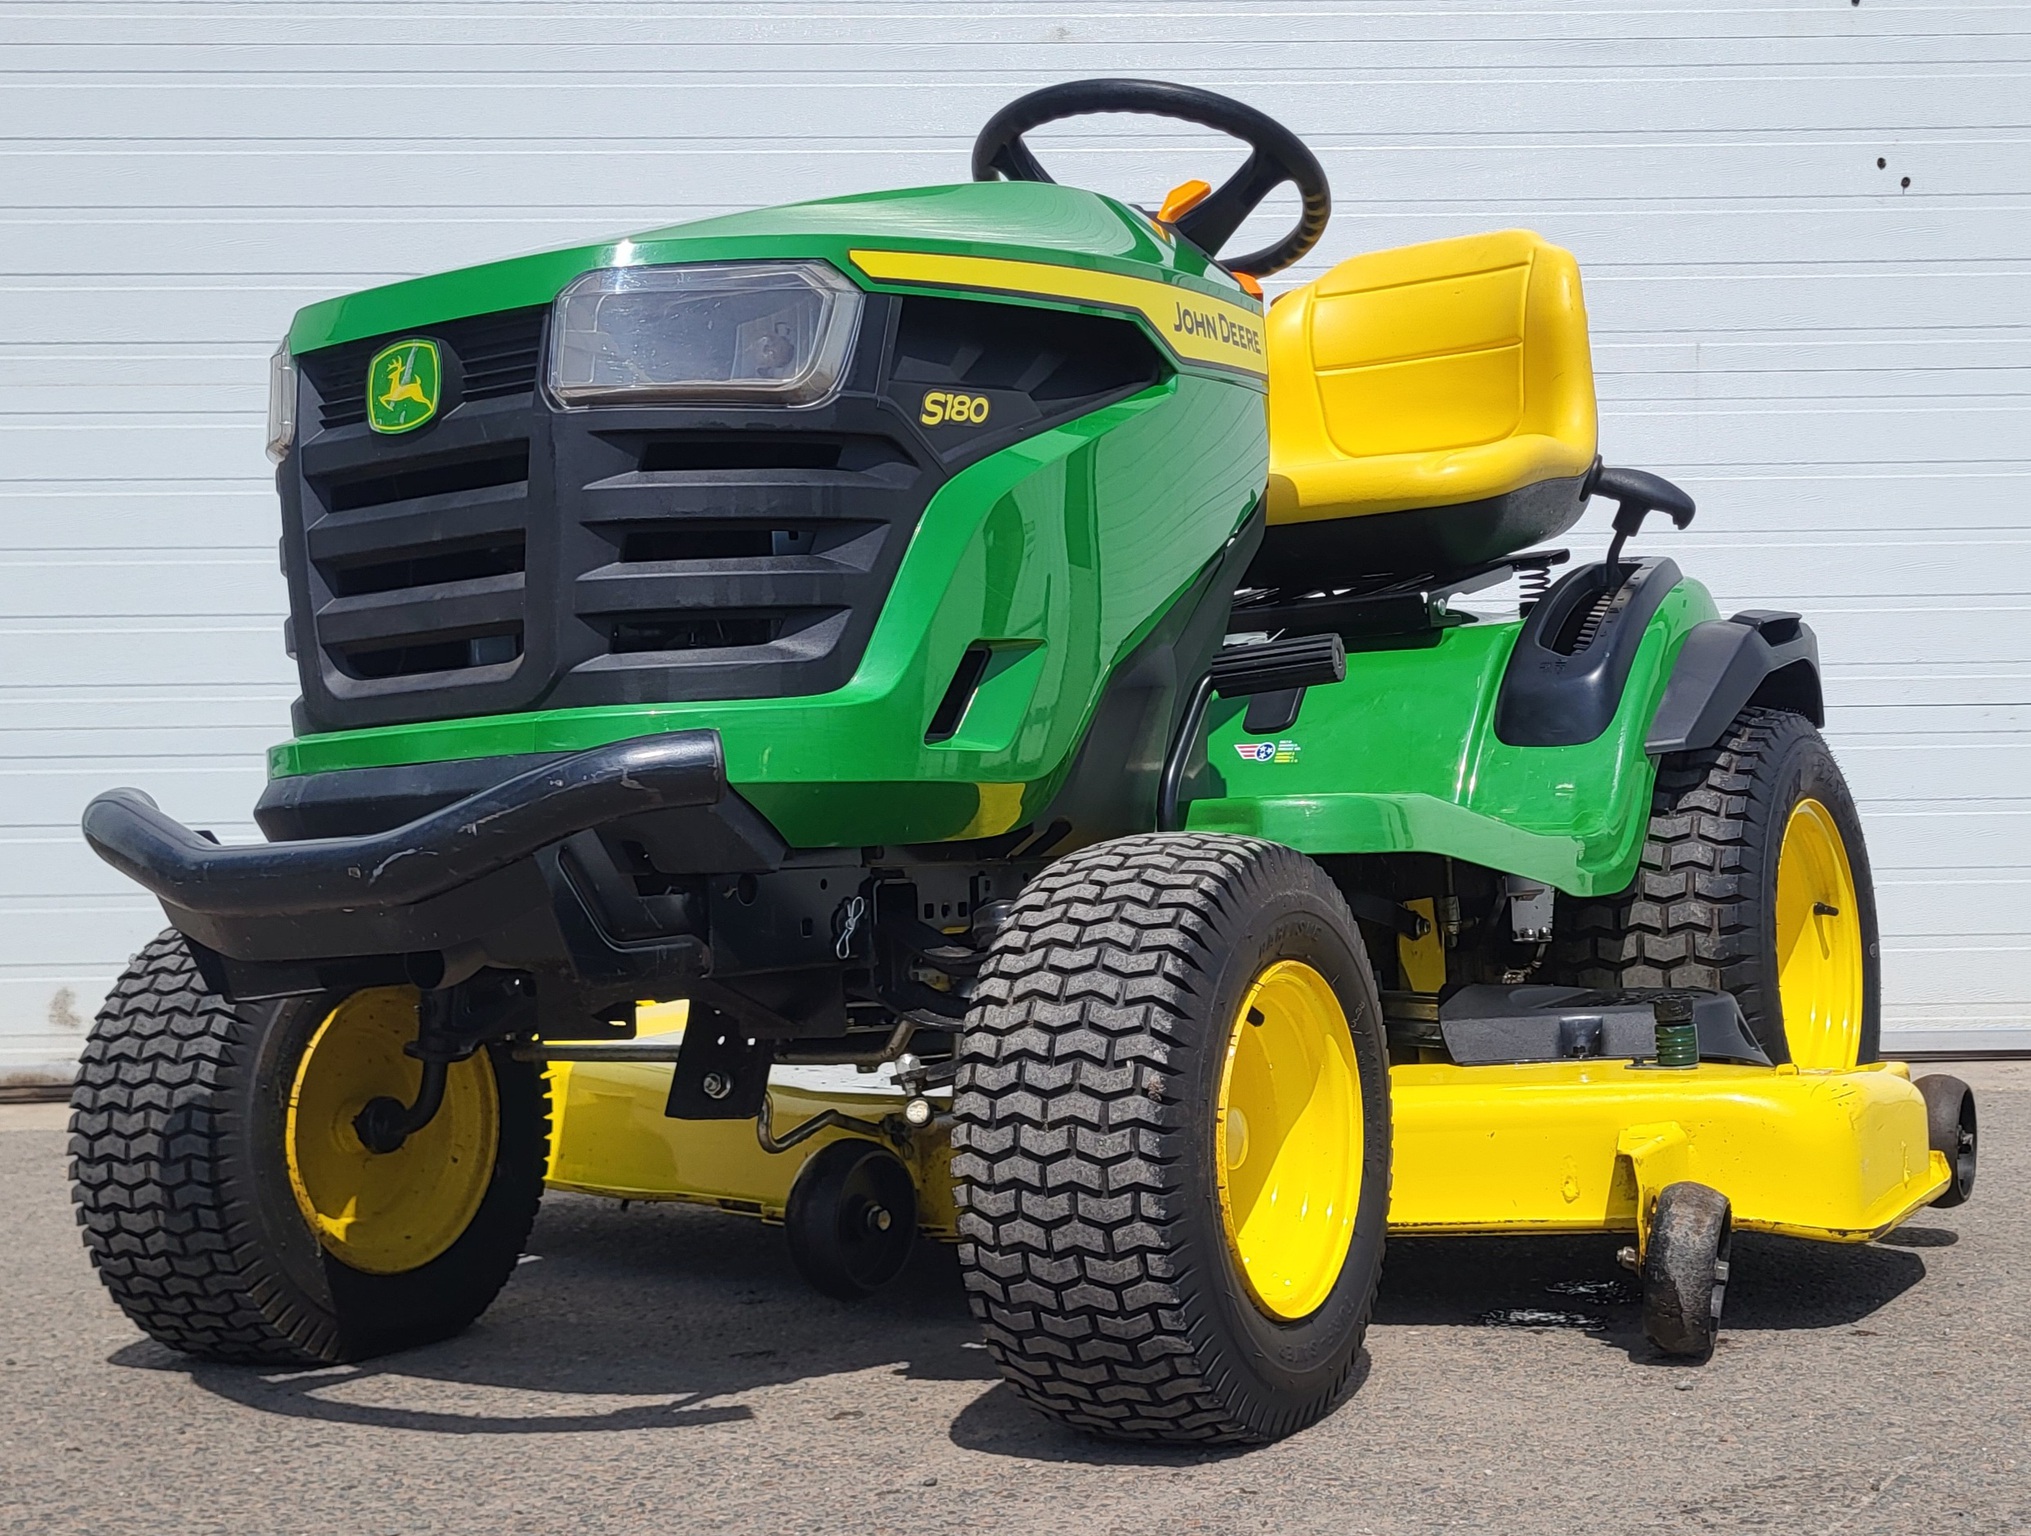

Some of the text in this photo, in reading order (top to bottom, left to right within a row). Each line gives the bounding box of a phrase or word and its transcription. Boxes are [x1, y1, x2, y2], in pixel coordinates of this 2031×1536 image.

[1174, 302, 1261, 355] JOHN DEERE
[921, 391, 989, 425] S180
